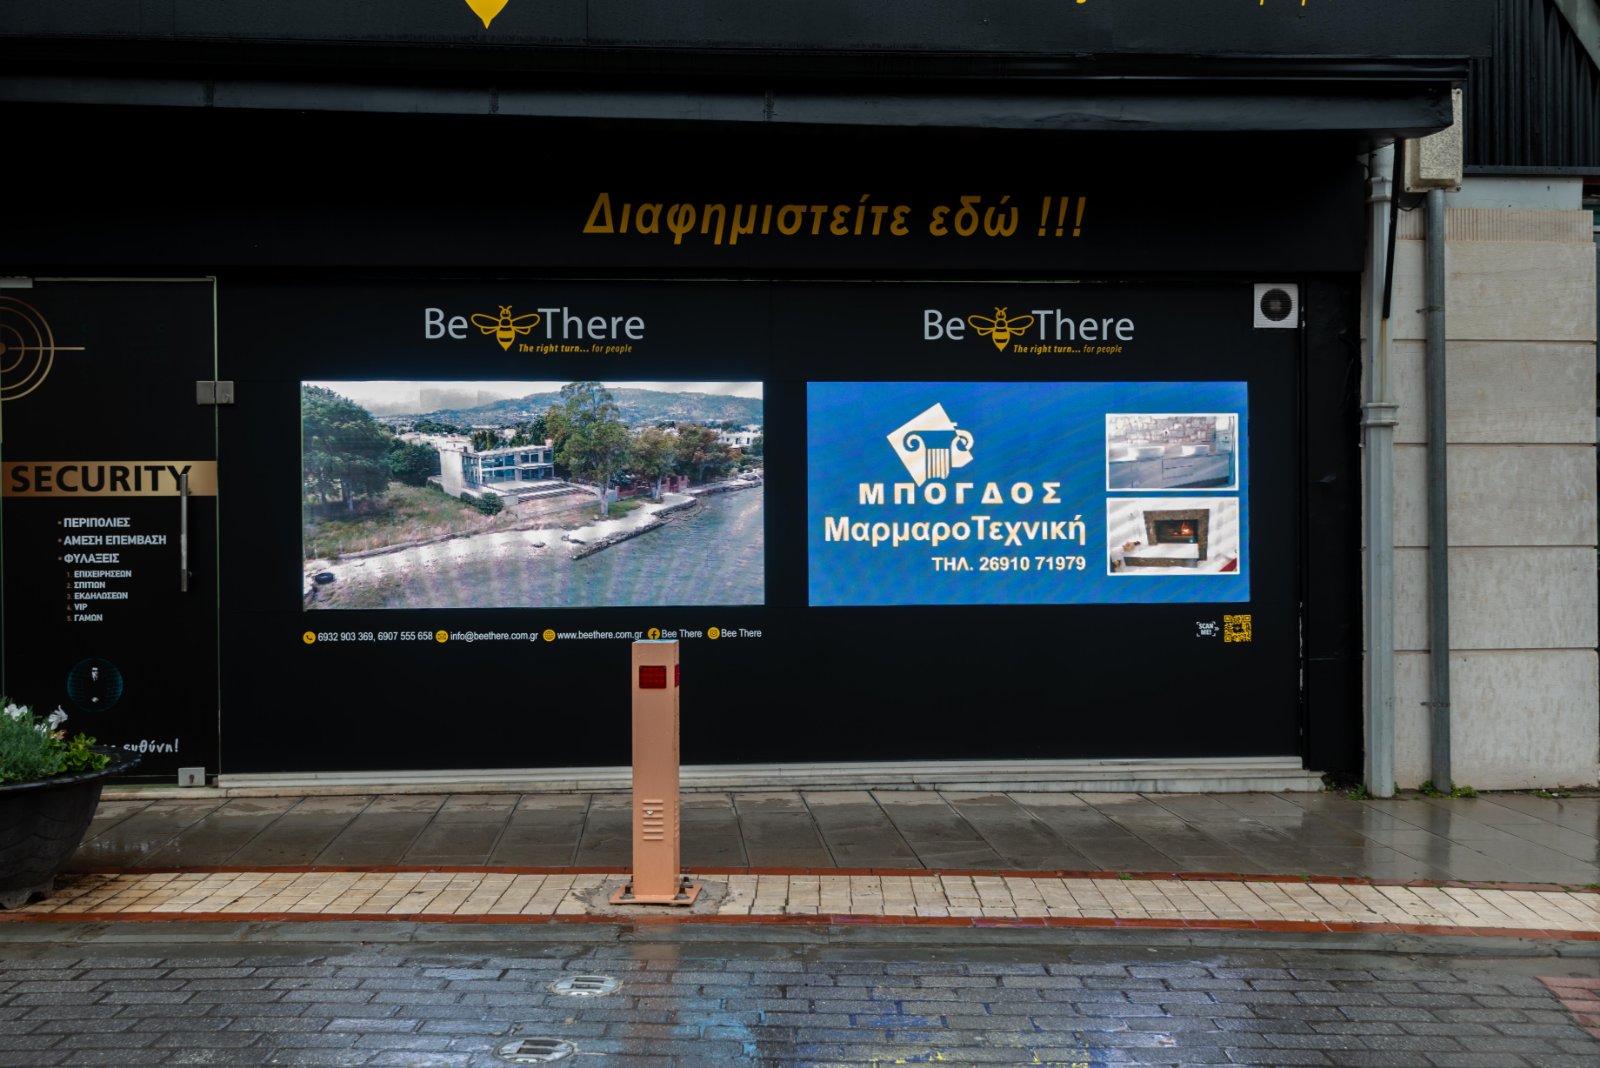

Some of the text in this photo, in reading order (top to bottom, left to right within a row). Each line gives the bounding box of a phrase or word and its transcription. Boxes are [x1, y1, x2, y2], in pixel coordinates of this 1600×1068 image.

[582, 191, 1087, 246] Διαφημιστείτε εδώ !!!
[424, 306, 645, 340] Be There
[923, 308, 1135, 341] Be There
[518, 343, 633, 355] The right turn... for people
[1013, 344, 1123, 356] The right turn... for people
[10, 465, 192, 493] SECURITY
[858, 482, 1062, 505] ΜΠΟΓΔΟΣ
[63, 517, 131, 528] ΠΕΡΙΠΟΛΙΕΣ
[824, 514, 1087, 548] ΜαρμαροΤεχνική
[63, 534, 167, 546] ΑΜΕΣΗ ΕΠΕΜΒΑΣΗ
[63, 553, 120, 564] ΦΥΛΑΞΕΙΣ
[931, 555, 1087, 572] ΤΗΛ. 26910 71979
[73, 570, 132, 578] ΕΠΙΧΕΙΡΗΣΕΩΝ
[73, 581, 106, 589] ΣΠΙΤΙΩΝ
[73, 592, 129, 600] ΕΚΔΗΛΩΣΕΩΝ
[73, 603, 88, 611] VIP
[73, 614, 103, 622] ΓΑΜΩΝ
[1198, 622, 1214, 630] SCAN
[317, 631, 433, 643] 6932 903 369, 6907 555 658
[450, 630, 539, 643] info@beethere.com.gr
[557, 629, 643, 641] www.beethere.com.gr
[661, 629, 703, 639] Bee There
[721, 628, 762, 638] Bee There
